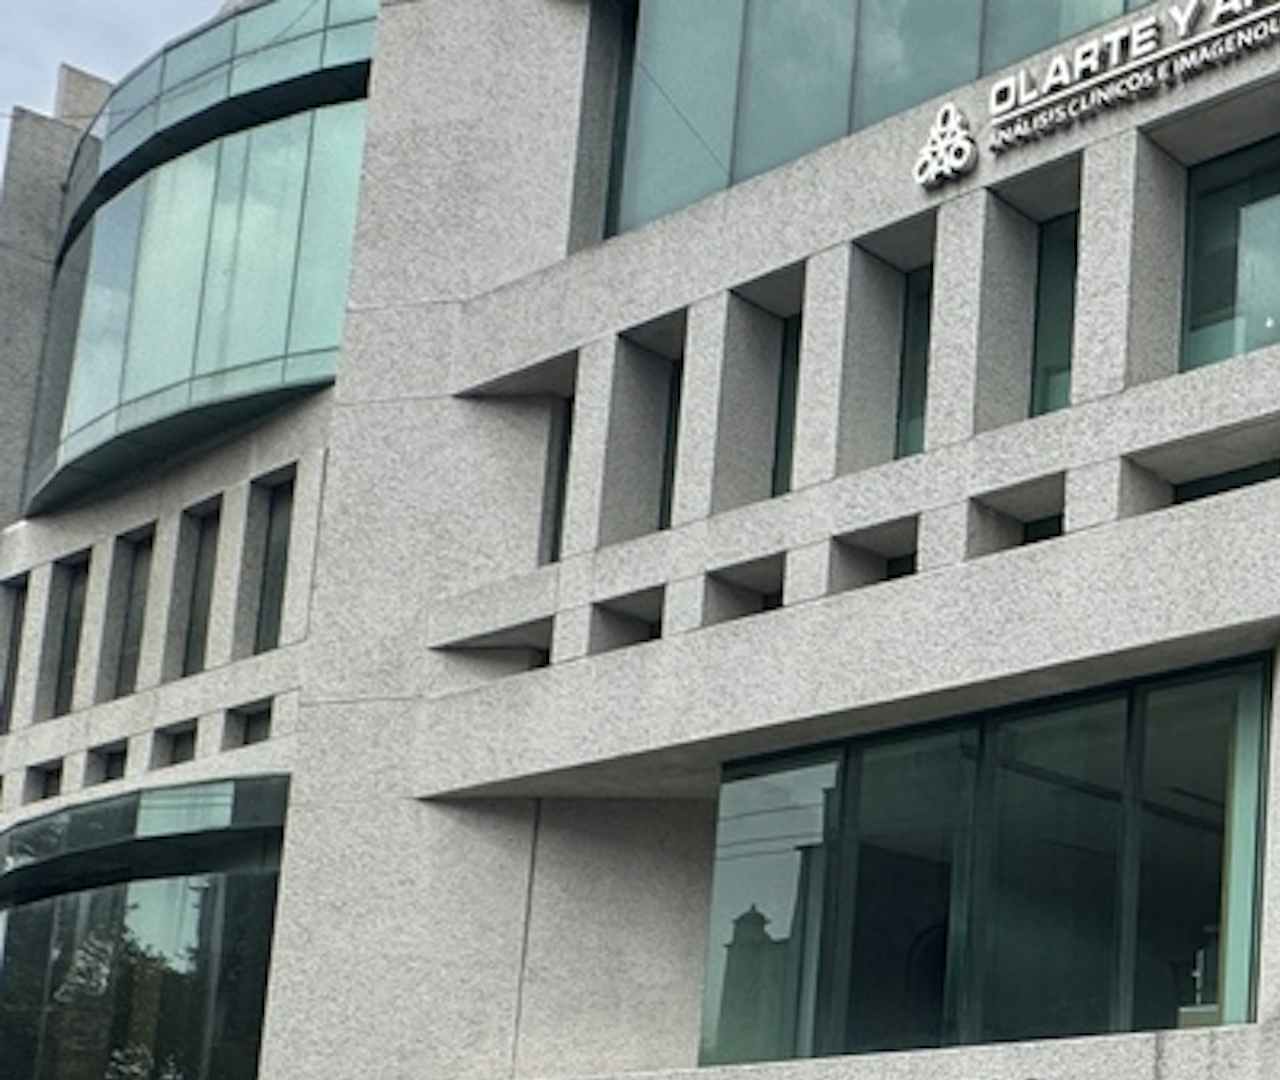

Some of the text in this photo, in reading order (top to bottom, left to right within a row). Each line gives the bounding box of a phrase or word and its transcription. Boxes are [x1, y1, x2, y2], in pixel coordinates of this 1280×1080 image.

[988, 14, 1159, 115] OLARTE
[1168, 0, 1201, 37] Y
[1157, 60, 1170, 81] E
